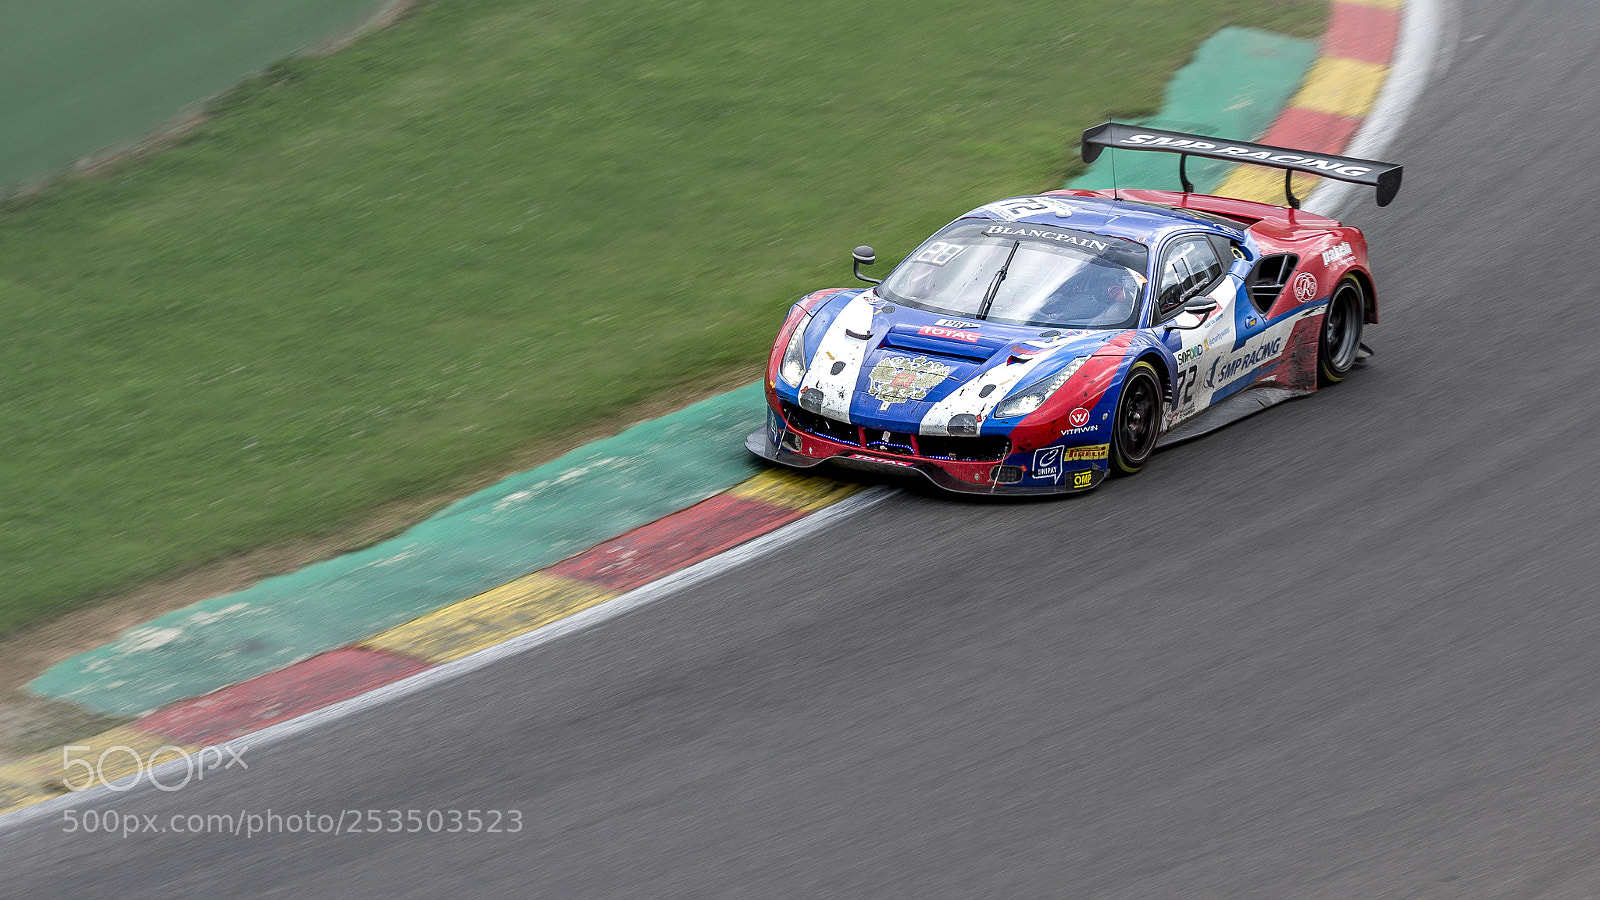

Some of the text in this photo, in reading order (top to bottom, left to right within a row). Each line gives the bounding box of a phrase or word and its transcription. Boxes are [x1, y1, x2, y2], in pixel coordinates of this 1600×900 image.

[1120, 134, 1373, 177] SMP RACING
[986, 225, 1109, 251] BLANCPAIN
[924, 325, 978, 342] TOTAL
[1218, 358, 1242, 383] SMP
[1241, 337, 1282, 371] RACING
[1177, 364, 1198, 405] 72
[1060, 424, 1099, 436] VITAWIN
[1068, 446, 1107, 458] PIRELLI
[1074, 473, 1092, 486] OMP
